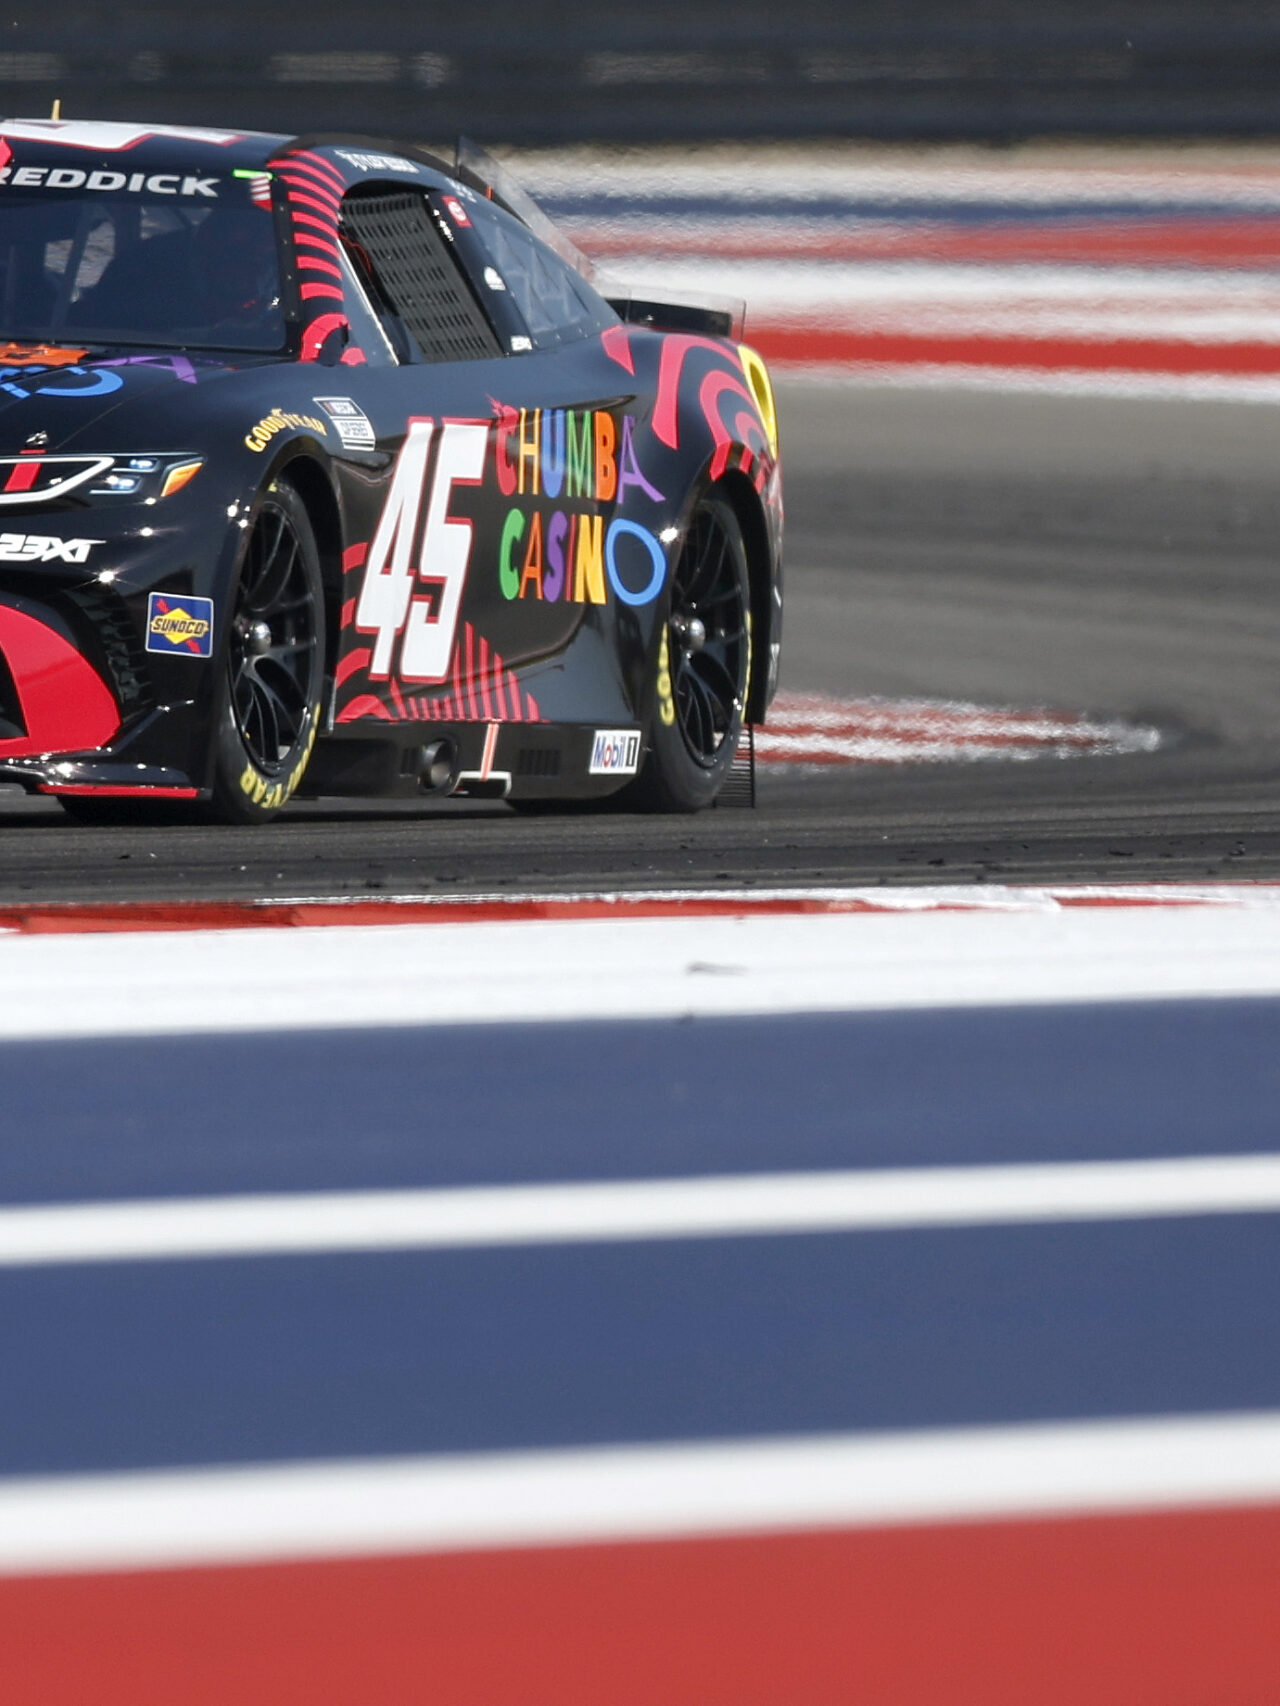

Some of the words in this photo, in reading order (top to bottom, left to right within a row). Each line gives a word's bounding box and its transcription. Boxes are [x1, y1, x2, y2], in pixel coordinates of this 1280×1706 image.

[495, 402, 666, 504] CHUMBA
[355, 416, 492, 684] 45
[498, 508, 667, 606] CASINO
[152, 617, 205, 635] SUNOCO
[592, 735, 625, 768] Mobil
